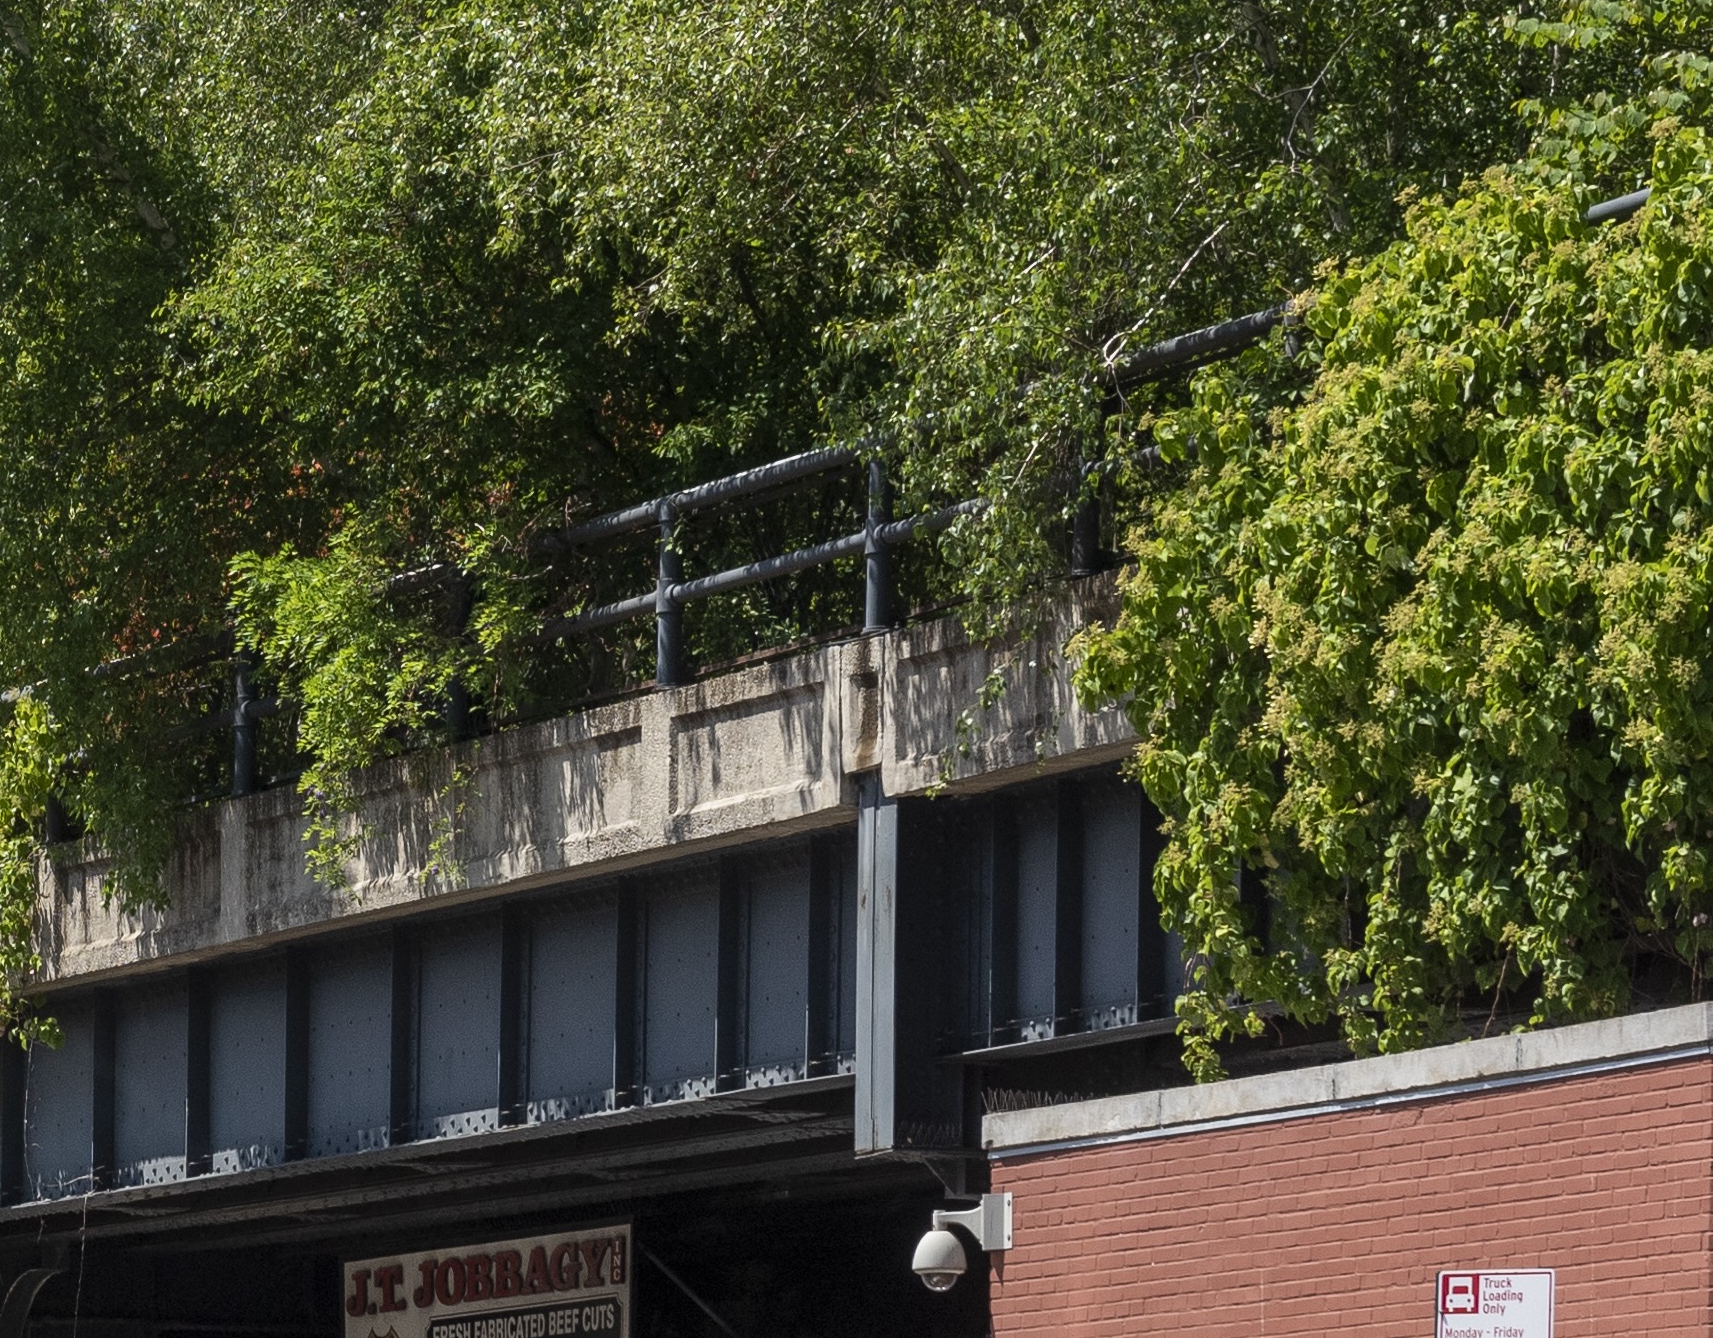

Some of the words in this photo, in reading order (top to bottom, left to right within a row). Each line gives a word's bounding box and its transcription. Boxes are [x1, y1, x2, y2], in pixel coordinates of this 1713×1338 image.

[346, 1264, 407, 1317] J.T.
[413, 1237, 611, 1309] JOBBAGY
[612, 1240, 621, 1282] INC
[1484, 1277, 1512, 1288] Truck
[1483, 1291, 1523, 1303] Loading
[1483, 1303, 1506, 1315] Only
[548, 1308, 579, 1334] BEEF
[582, 1303, 615, 1332] CUTS
